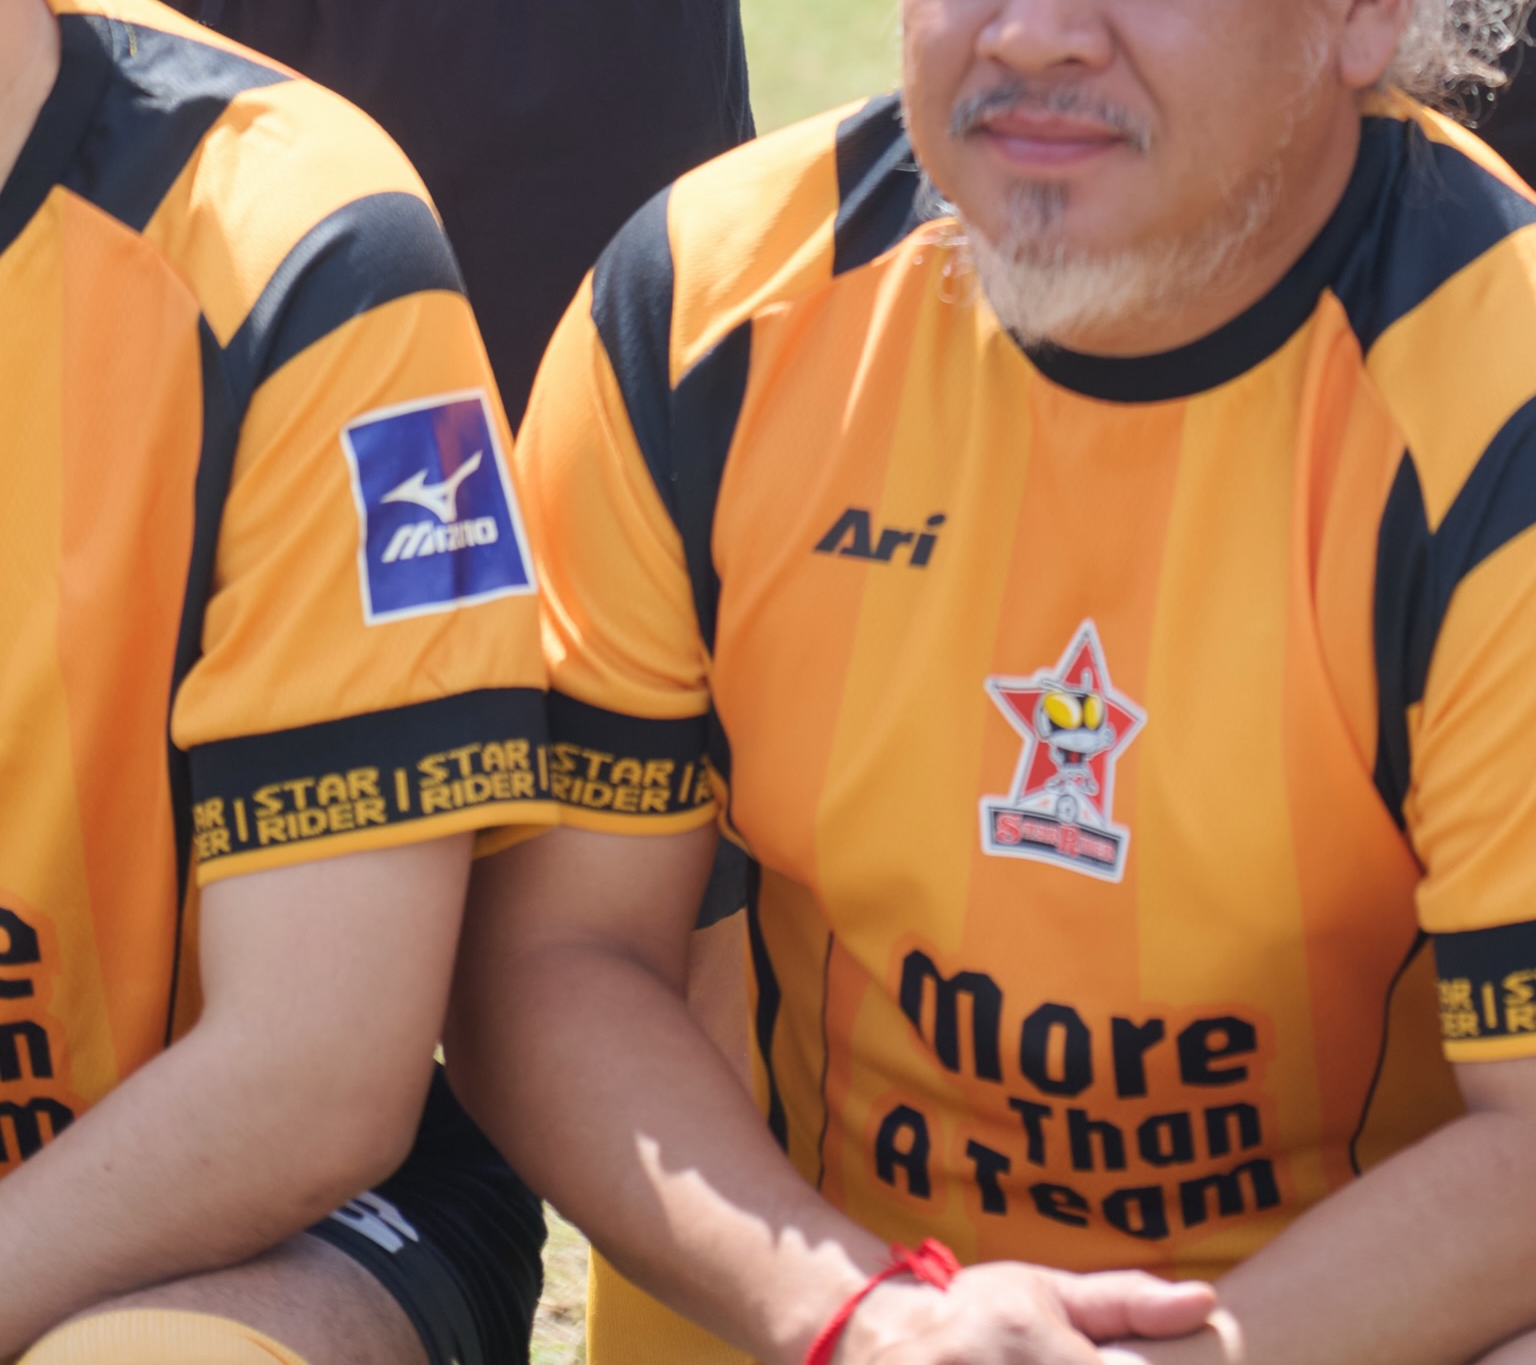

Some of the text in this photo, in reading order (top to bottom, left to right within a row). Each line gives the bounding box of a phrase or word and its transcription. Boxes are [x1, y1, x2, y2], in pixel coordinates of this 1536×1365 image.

[816, 509, 945, 566] Ari
[416, 738, 530, 786] STAR
[551, 742, 676, 788] STAR
[253, 768, 380, 820] STAR
[419, 769, 536, 815] RIDER
[550, 770, 671, 813] RIDER
[257, 796, 388, 846] RIDER
[899, 949, 1259, 1101] More
[1008, 1096, 1262, 1172] Than
[875, 1103, 1282, 1242] A Team
